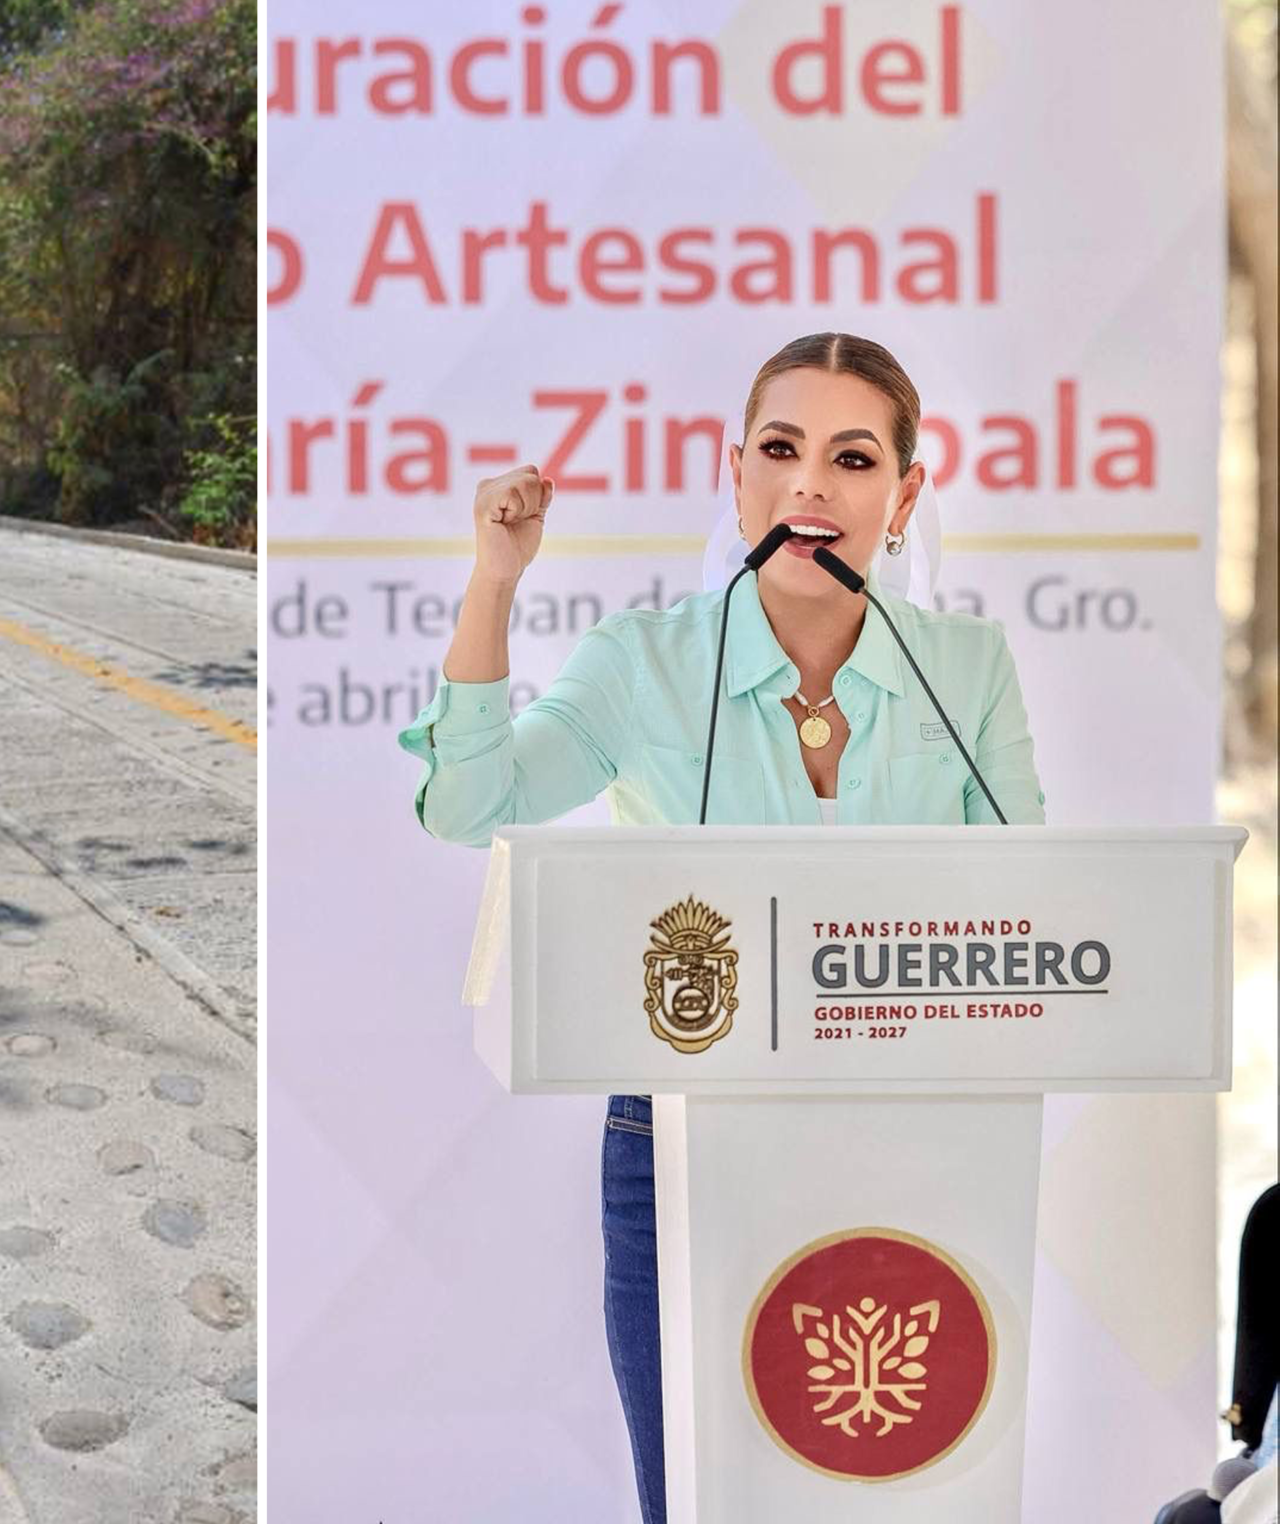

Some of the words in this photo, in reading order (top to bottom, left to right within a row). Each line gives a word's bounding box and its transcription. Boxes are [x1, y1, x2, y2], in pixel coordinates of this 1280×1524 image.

[770, 3, 962, 119] del
[350, 189, 999, 307] Artesanal
[270, 579, 349, 639] de
[371, 580, 604, 638] Tean
[1025, 574, 1152, 632] Gro.
[297, 666, 437, 727] abril
[813, 919, 1032, 938] TRANSFORMANDO
[811, 940, 1112, 990] GUERRERO
[814, 1004, 917, 1021] GOBIERNO
[923, 1004, 960, 1019] DEL
[966, 1002, 1044, 1019] ESTADO
[814, 1027, 852, 1040] 2021
[868, 1025, 907, 1039] 2027
